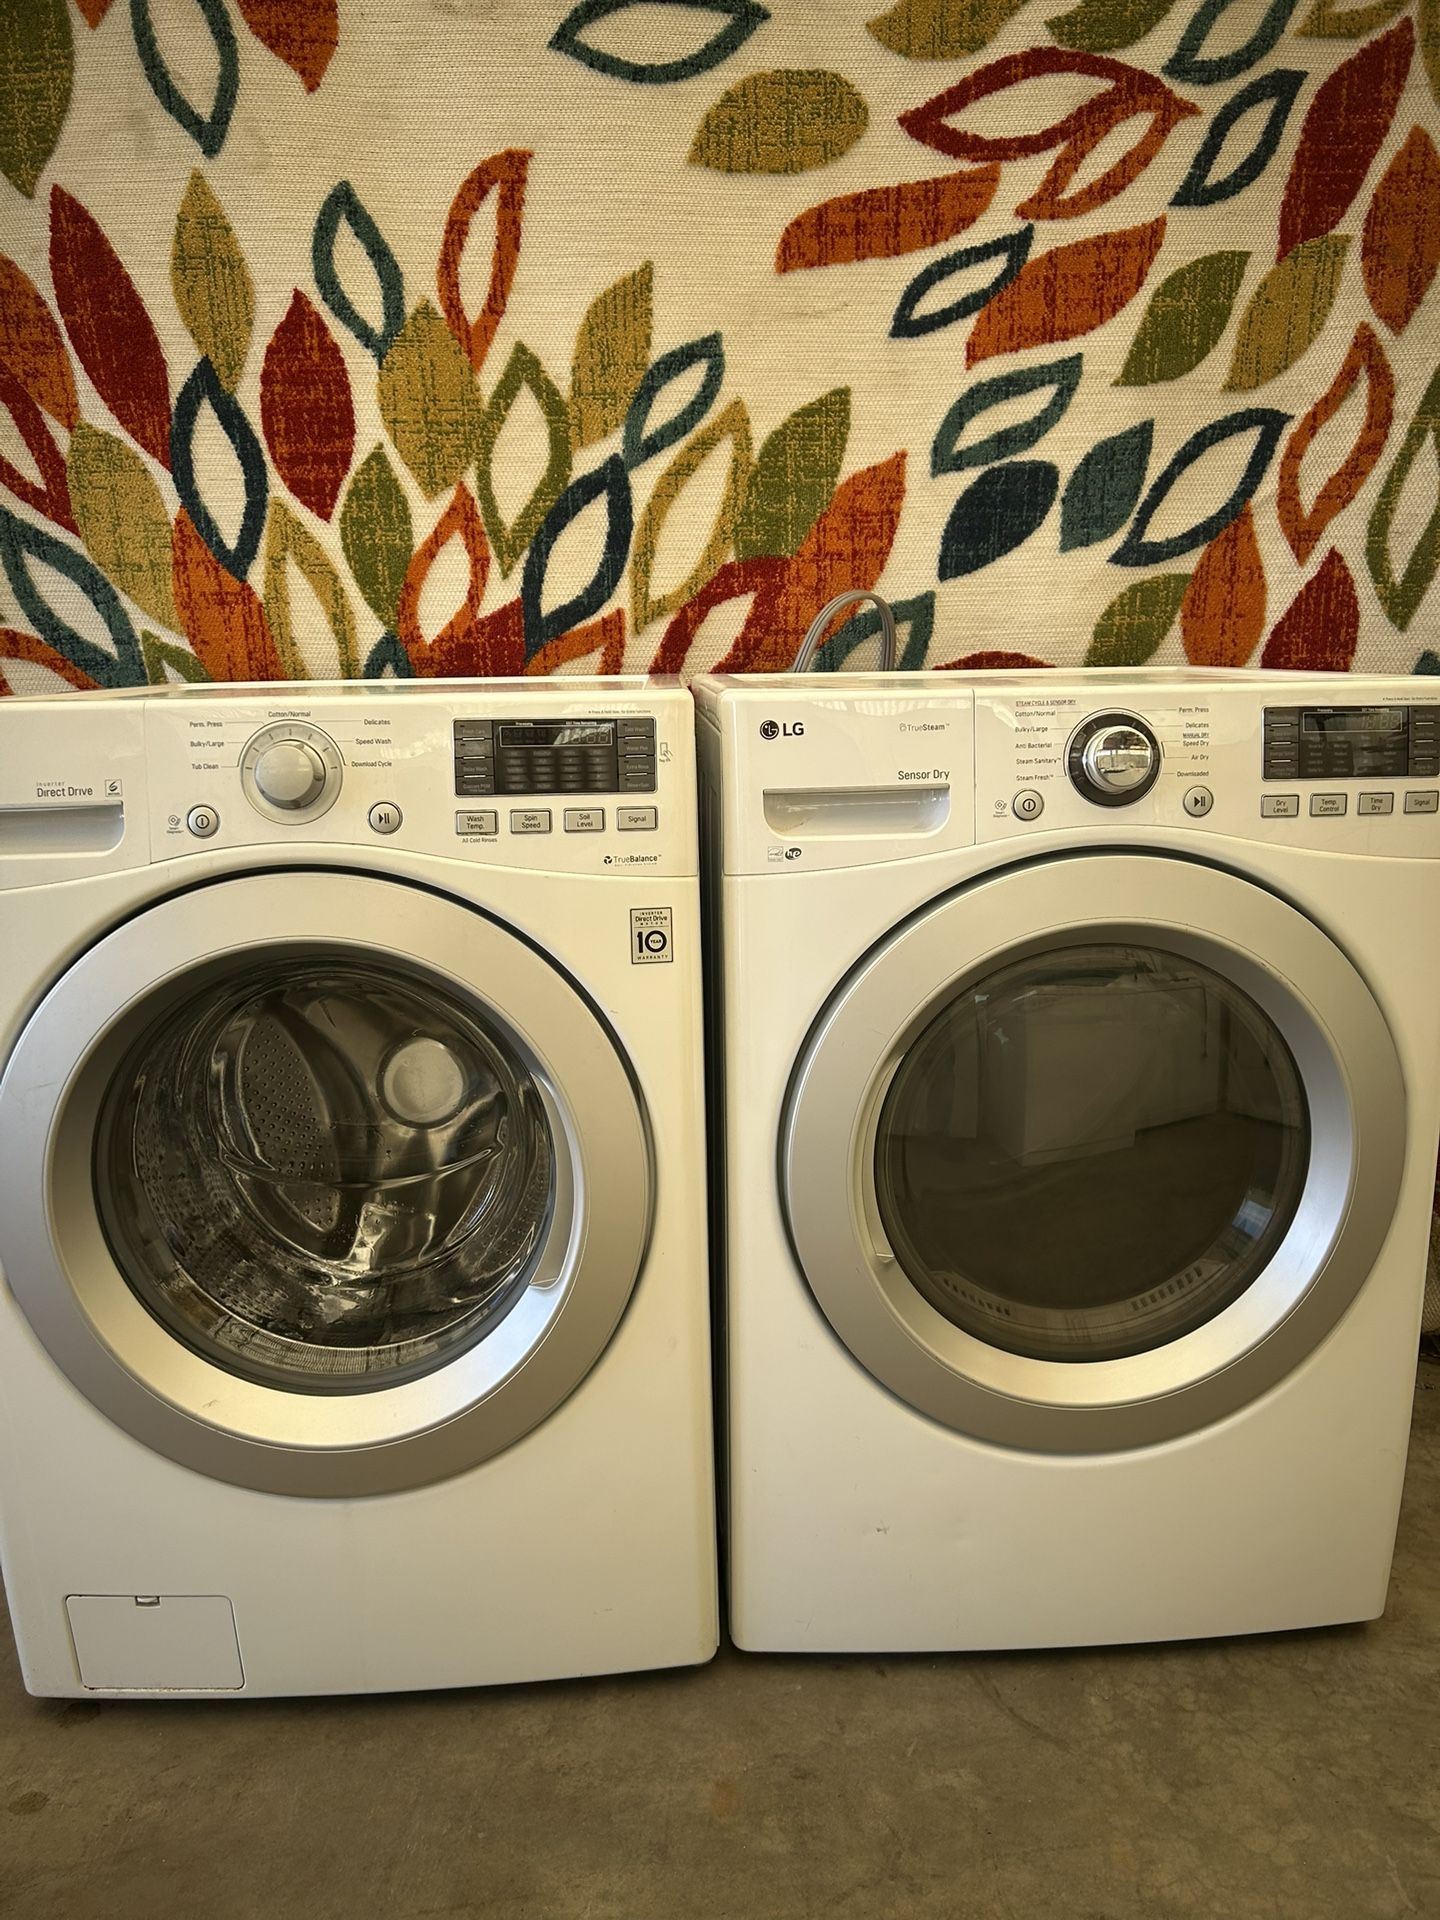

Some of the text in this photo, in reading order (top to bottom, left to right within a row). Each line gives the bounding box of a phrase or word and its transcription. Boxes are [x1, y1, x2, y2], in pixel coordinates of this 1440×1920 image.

[783, 722, 805, 736] LG
[898, 769, 950, 780] Sensor Dry
[37, 786, 93, 797] Direct Drive
[628, 815, 646, 823] Signal
[521, 821, 541, 829] Speed
[637, 930, 667, 953] 10
